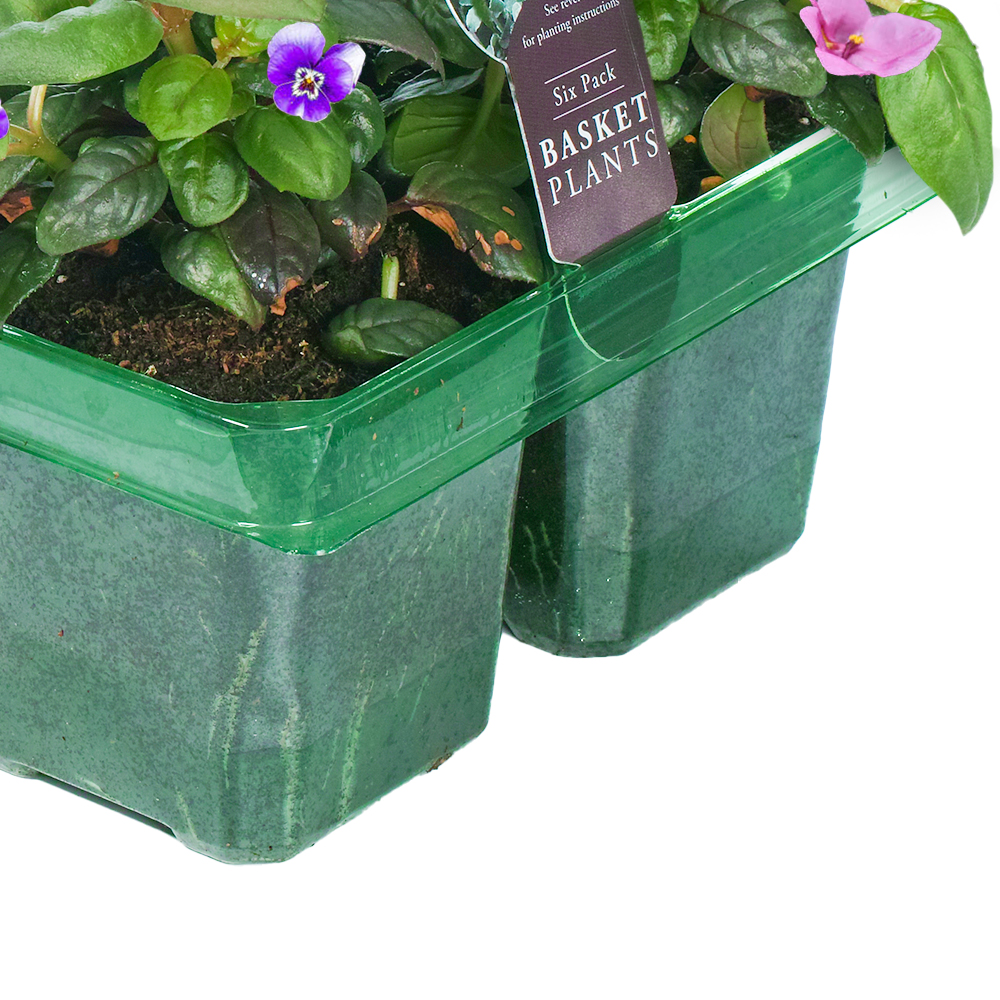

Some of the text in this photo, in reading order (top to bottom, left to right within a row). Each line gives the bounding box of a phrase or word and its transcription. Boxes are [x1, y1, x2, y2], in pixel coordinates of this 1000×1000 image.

[543, 2, 560, 17] See
[521, 34, 536, 49] for
[537, 18, 573, 47] planting
[552, 62, 617, 108] Six Pack
[538, 90, 649, 169] BASKET
[547, 128, 659, 206] PLANTS
